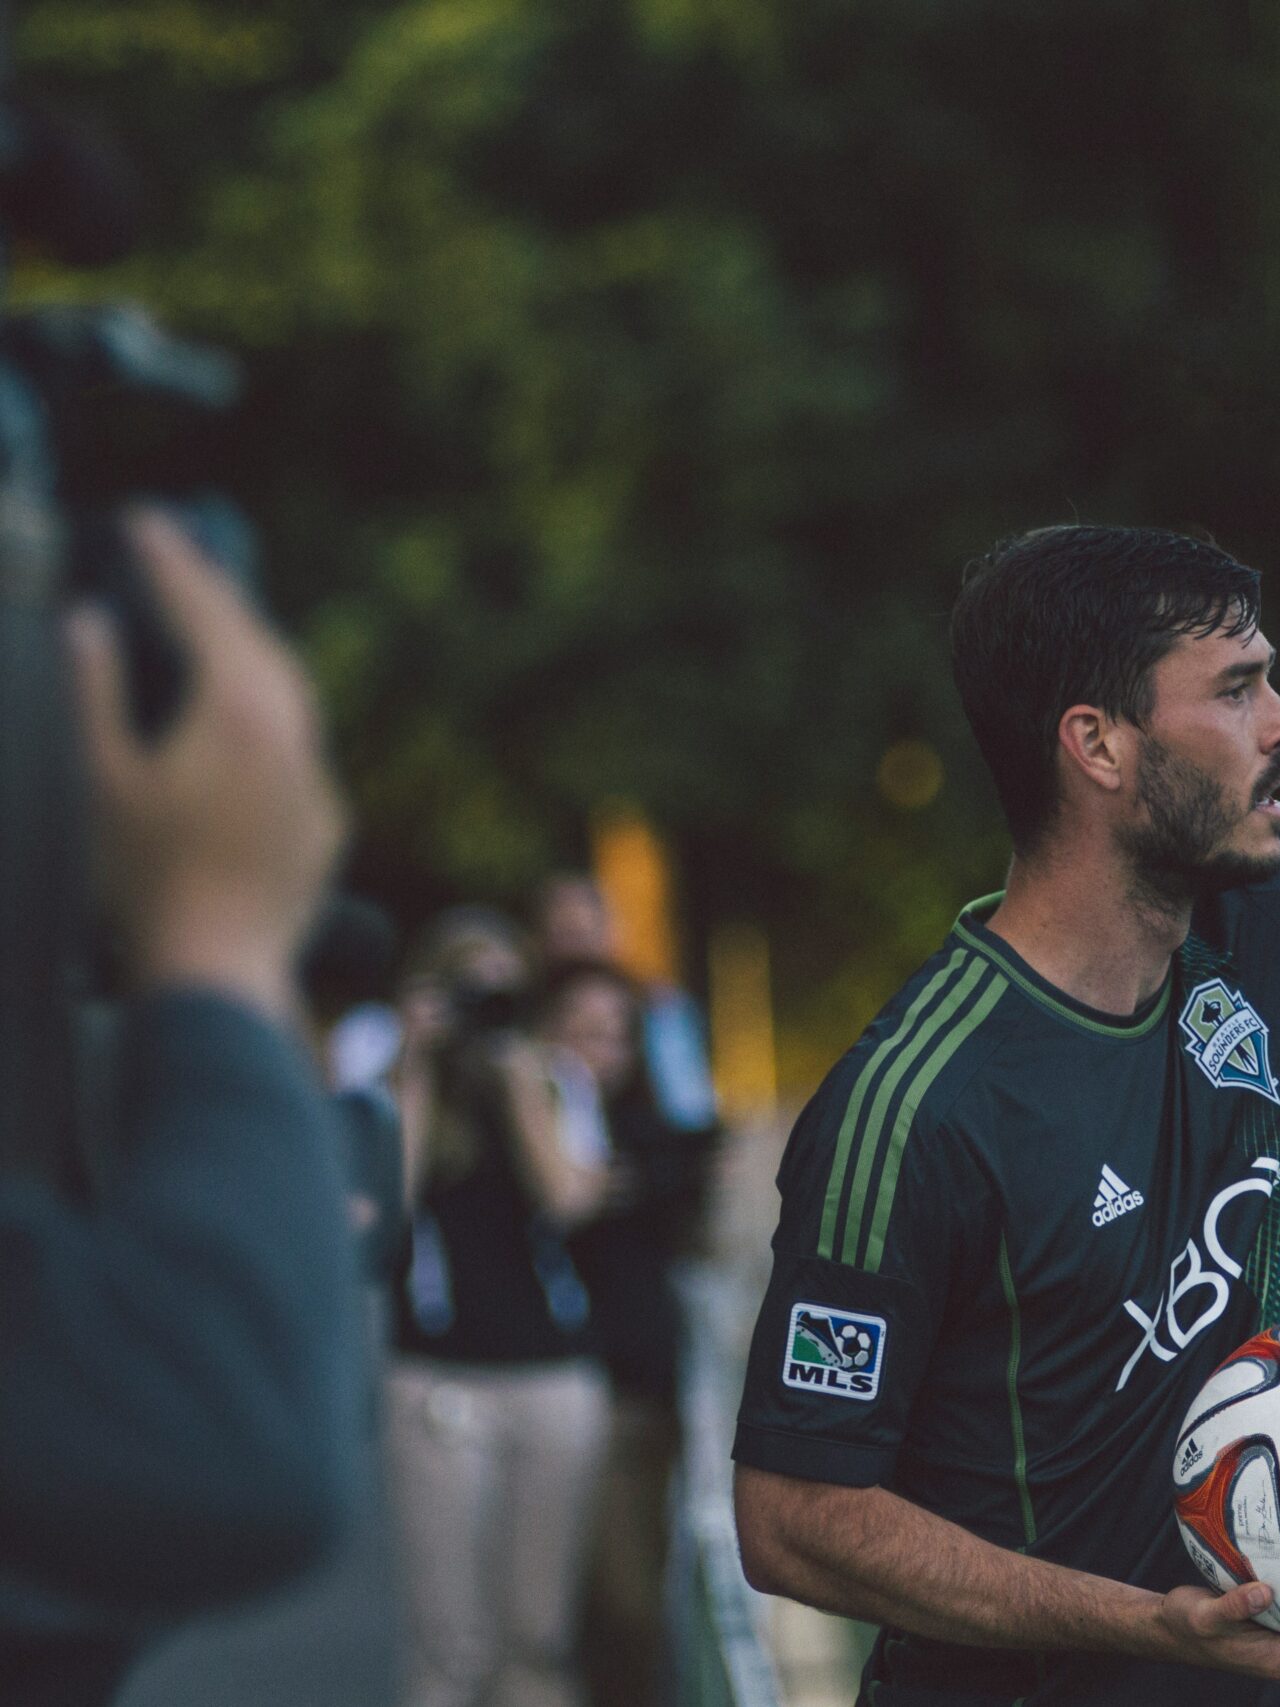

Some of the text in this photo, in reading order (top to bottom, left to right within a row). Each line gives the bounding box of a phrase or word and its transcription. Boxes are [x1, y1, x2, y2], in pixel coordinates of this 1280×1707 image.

[1208, 1018, 1258, 1072] SOUNDERS FC
[1092, 1190, 1145, 1227] adidas
[788, 1363, 873, 1393] MLS
